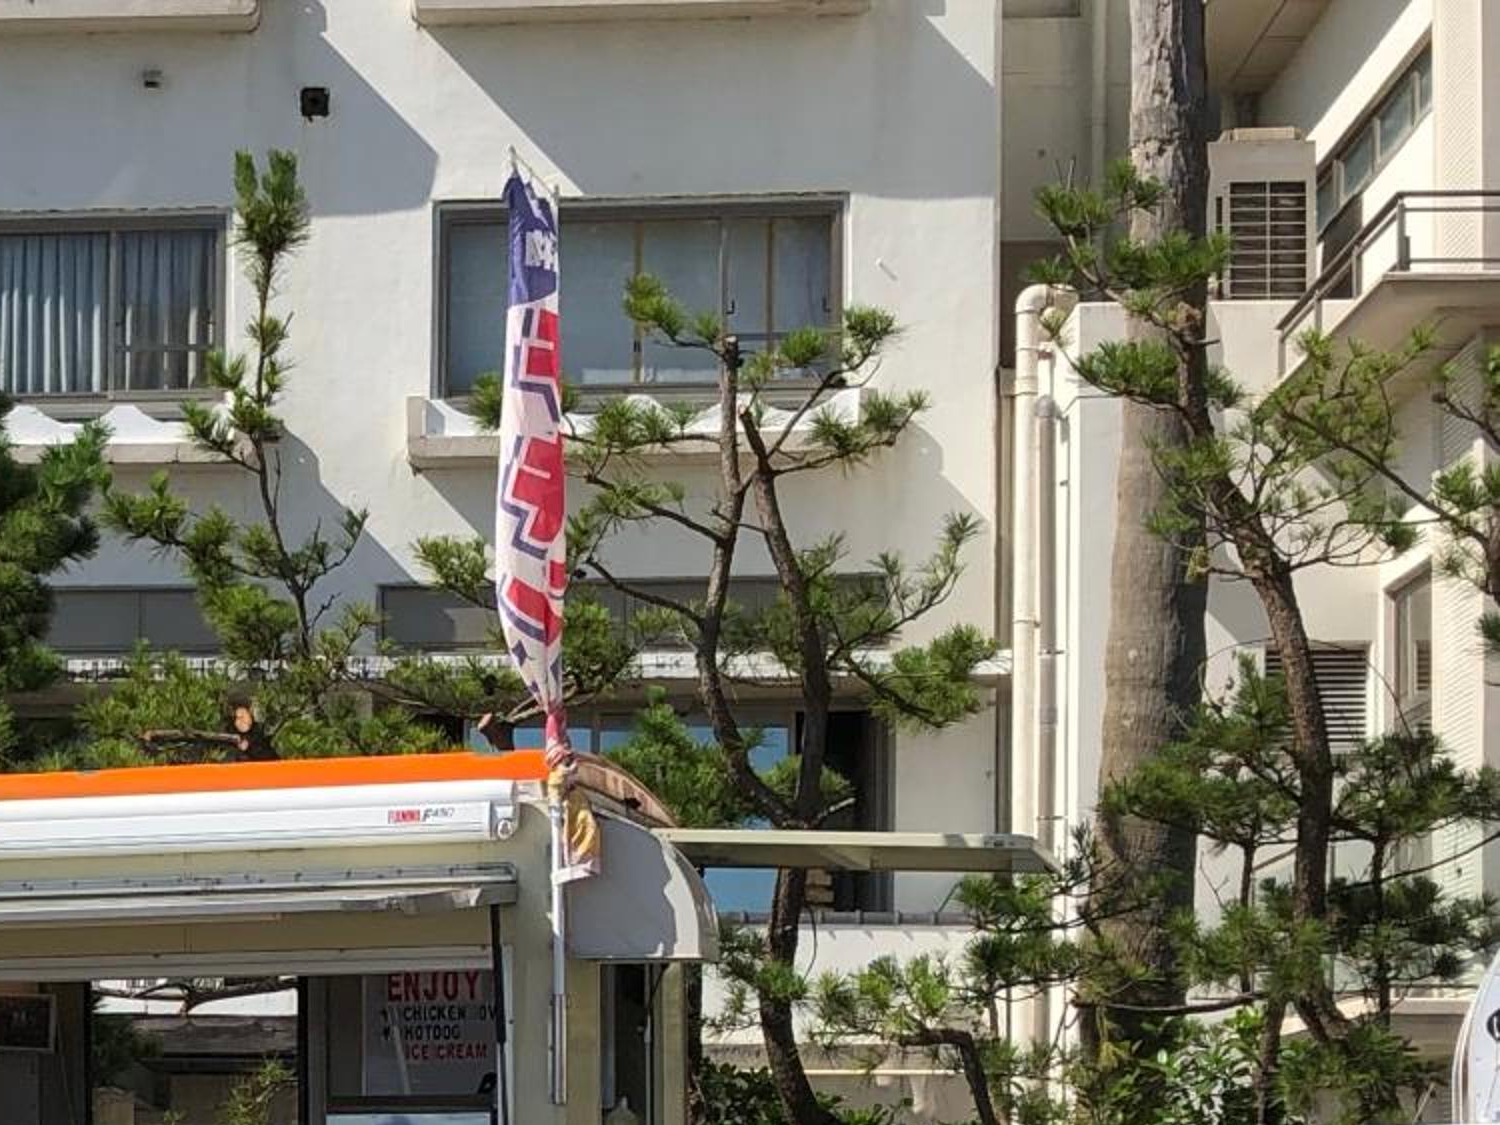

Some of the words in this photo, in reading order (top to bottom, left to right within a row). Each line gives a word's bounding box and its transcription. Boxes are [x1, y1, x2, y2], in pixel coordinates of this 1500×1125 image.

[387, 970, 479, 1001] ENJOY
[404, 1004, 467, 1021] CHICKEN
[405, 1026, 461, 1041] HOTDOG
[437, 1043, 487, 1061] CREAM
